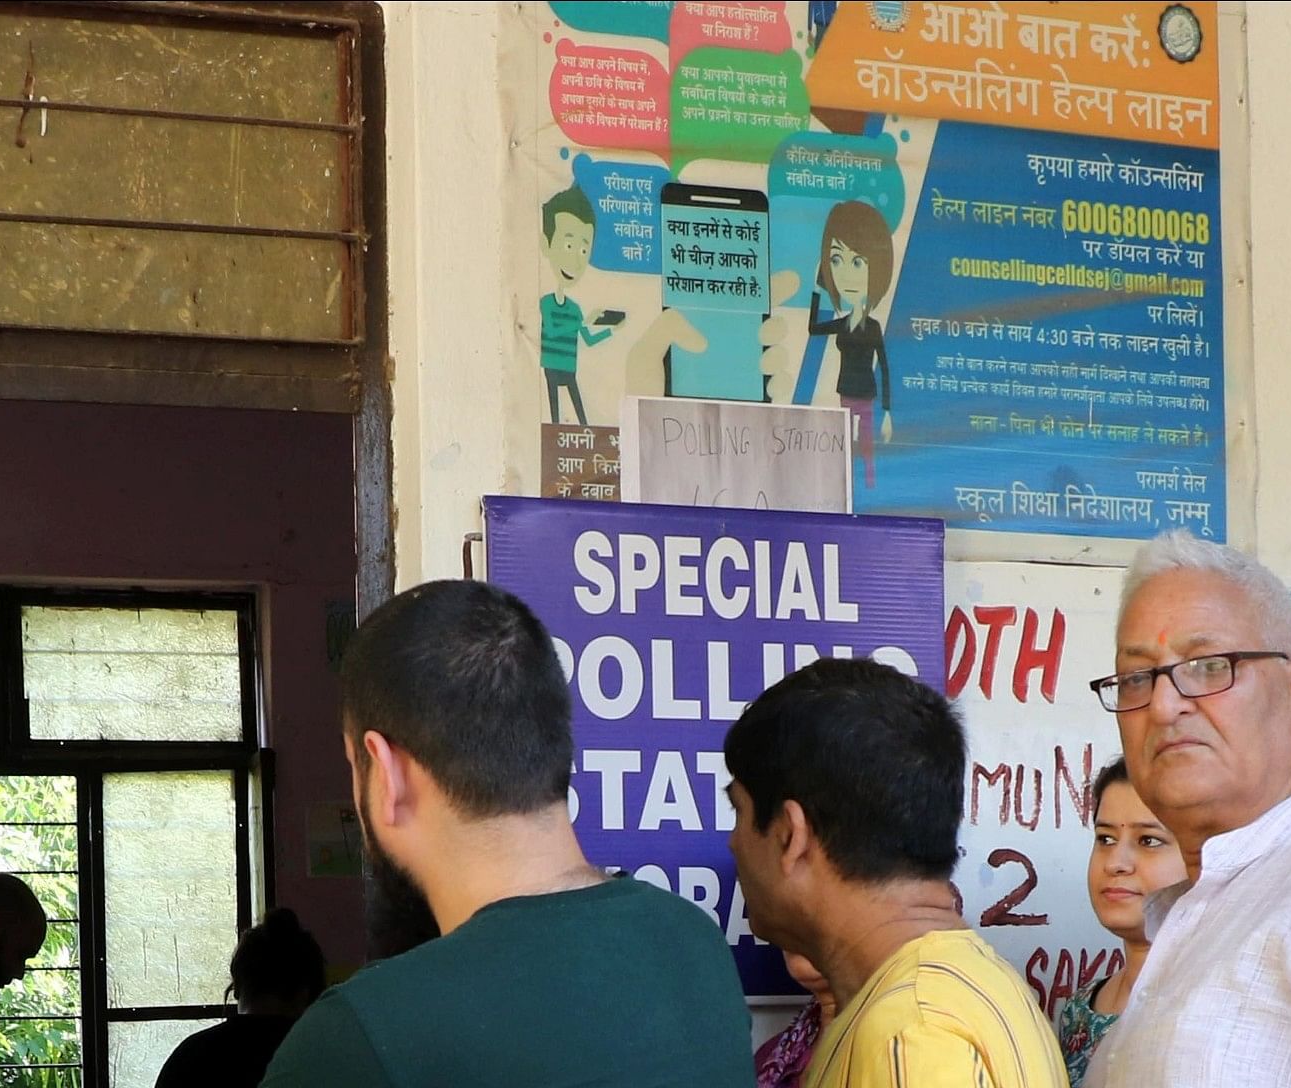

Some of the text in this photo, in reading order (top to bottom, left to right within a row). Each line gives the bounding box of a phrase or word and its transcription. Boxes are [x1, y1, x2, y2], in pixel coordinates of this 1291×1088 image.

[920, 2, 1009, 50] आओ
[1016, 11, 1079, 59] बात
[1050, 64, 1118, 125] हेल्प
[1126, 89, 1212, 138] लाइन
[603, 174, 634, 191] परीक्षा
[1027, 154, 1073, 187] कृपया
[1077, 153, 1113, 183] हमारे
[667, 216, 761, 241] क्या इनमें से कोई
[932, 196, 966, 222] हेल्प
[972, 202, 1016, 226] लाइन
[1062, 199, 1209, 244] 6006800068
[671, 246, 686, 265] भी
[718, 248, 757, 270] आपको
[1082, 239, 1102, 258] पर
[1156, 242, 1183, 267] करें
[1187, 250, 1205, 269] या
[667, 272, 704, 293] परेशान
[707, 278, 727, 295] कर
[728, 275, 746, 296] रही
[950, 257, 1205, 298] counsellingcelldsej@gmail.com
[1147, 304, 1164, 324] पर
[910, 317, 941, 342] सुबह
[945, 319, 960, 338] 10
[965, 316, 989, 340] बजे
[992, 317, 1004, 340] से
[1007, 320, 1033, 343] सायं
[1036, 329, 1068, 347] 4:30
[1071, 324, 1095, 350] बजे
[1099, 333, 1122, 351] तक
[1125, 335, 1159, 354] लाइन
[1162, 336, 1191, 361] खुली
[557, 428, 596, 450] अपनी
[662, 417, 846, 457] POLLING STATION
[557, 456, 585, 474] आप
[1181, 466, 1207, 493] सेल
[954, 487, 1006, 523] स्कूल
[1012, 481, 1059, 518] शिक्षा
[1165, 499, 1214, 536] जम्मू
[573, 530, 860, 623] SPECIAL
[944, 604, 1067, 704] OTH
